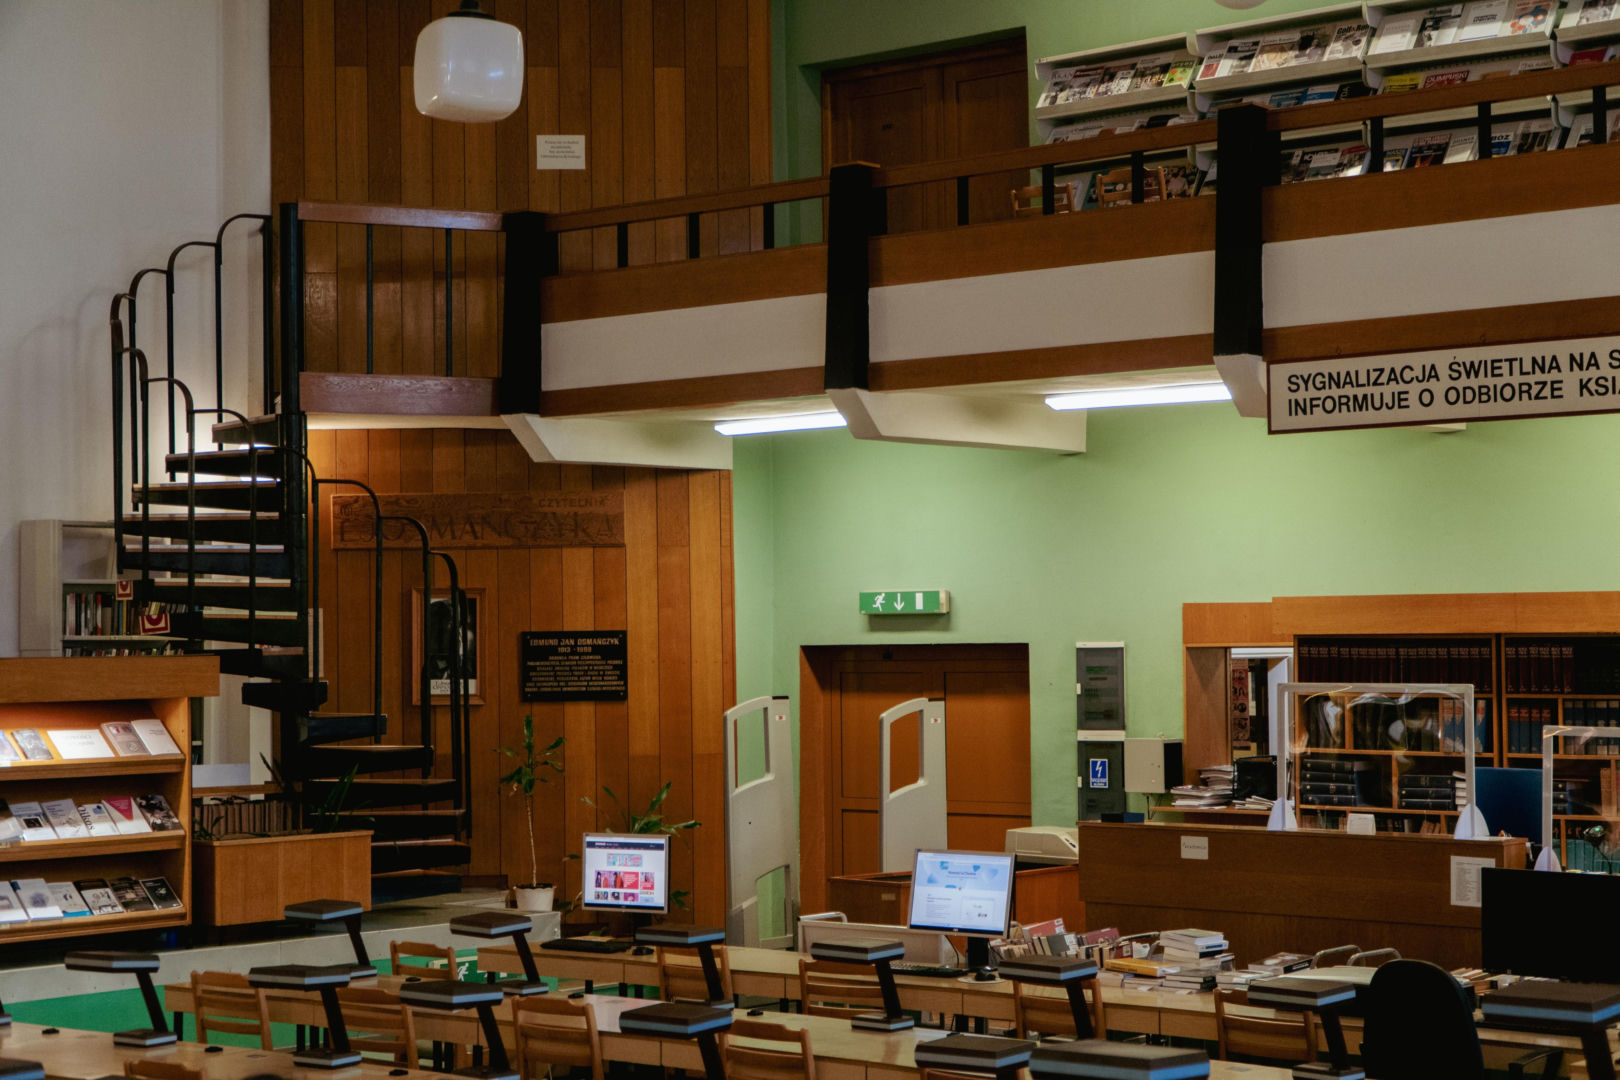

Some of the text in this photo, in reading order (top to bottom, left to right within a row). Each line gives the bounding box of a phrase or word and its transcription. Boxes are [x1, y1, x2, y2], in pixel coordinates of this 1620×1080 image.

[1287, 363, 1441, 393] SYGNALIZACJA
[1448, 355, 1562, 381] ŚWIETLNA
[1569, 351, 1601, 373] NA
[1288, 375, 1620, 417] INFORMUJE O ODBIORZE KSI
[560, 638, 575, 646] JAN
